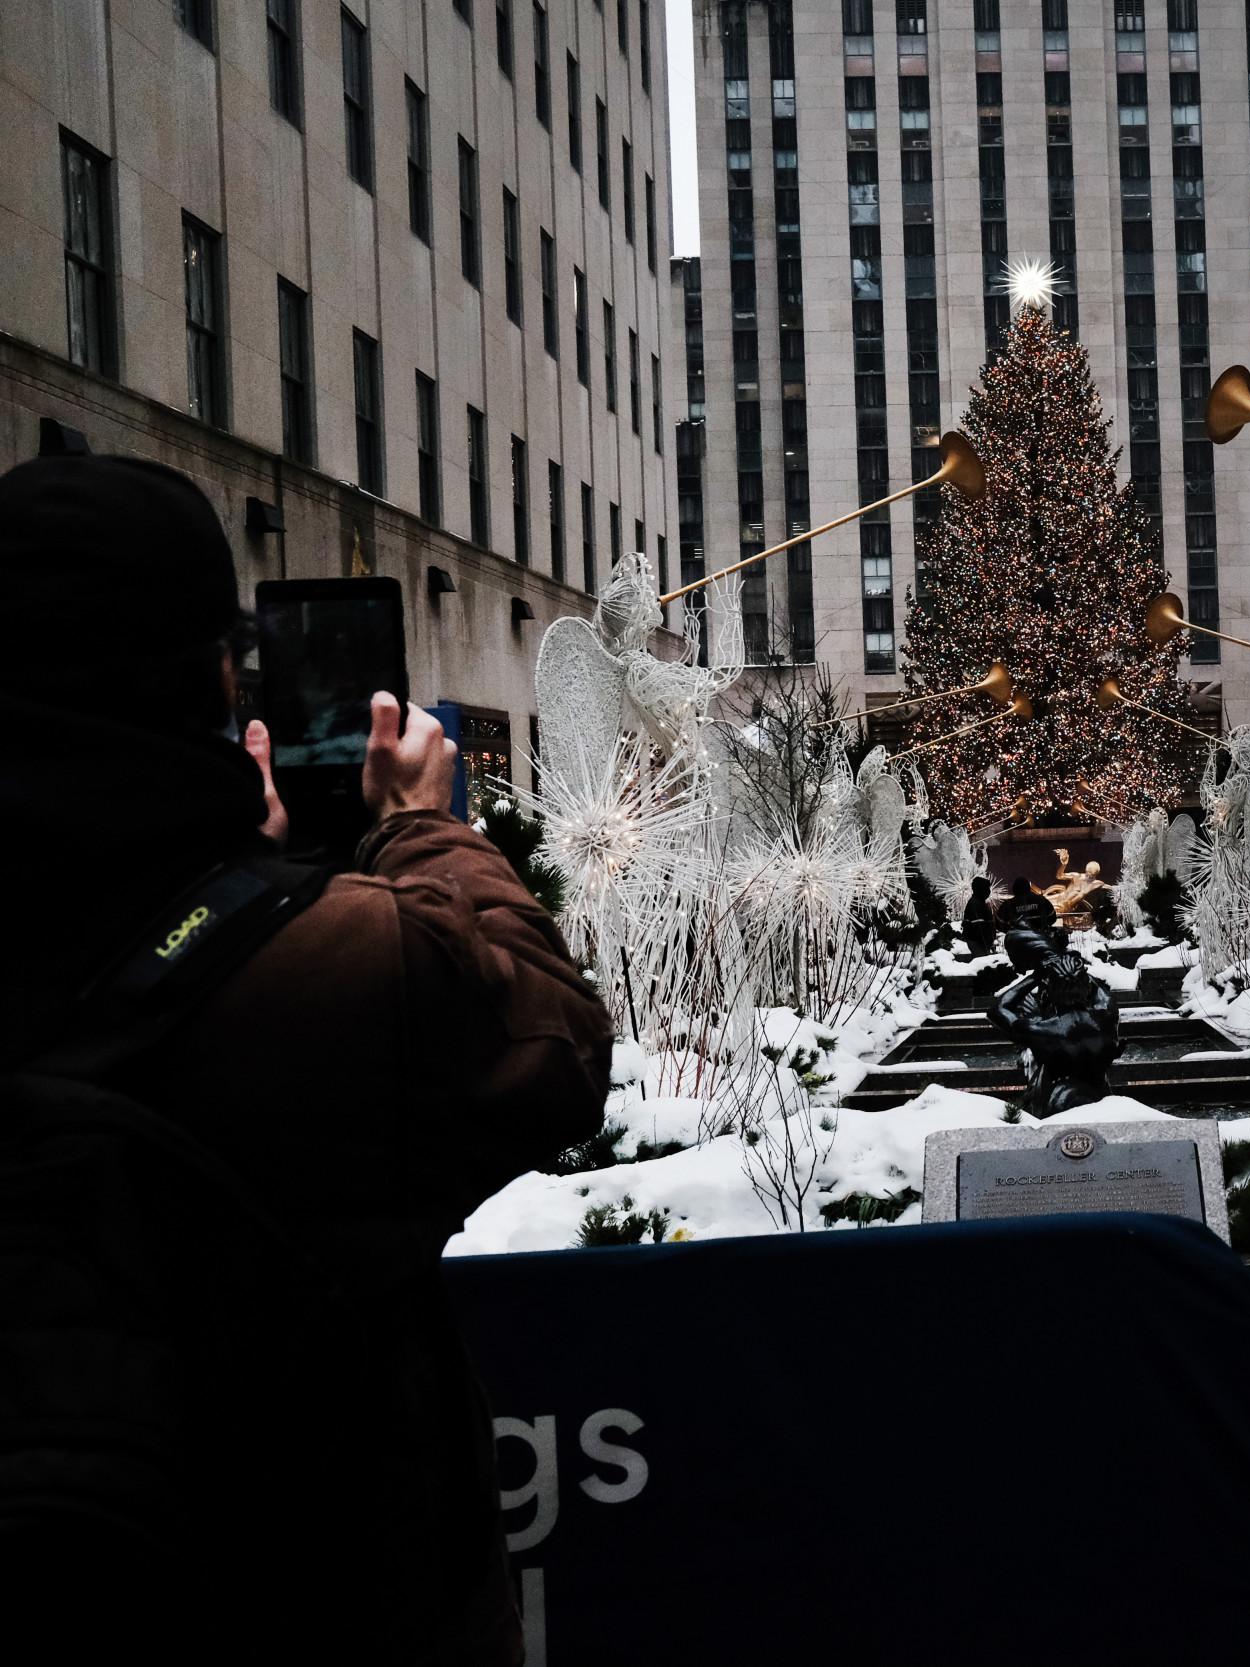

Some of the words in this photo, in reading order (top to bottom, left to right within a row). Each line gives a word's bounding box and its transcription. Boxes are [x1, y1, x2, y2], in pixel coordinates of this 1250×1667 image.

[996, 1171, 1097, 1187] ROCKEFELLER
[1106, 1168, 1162, 1181] CENTER
[492, 1407, 650, 1553] gs
